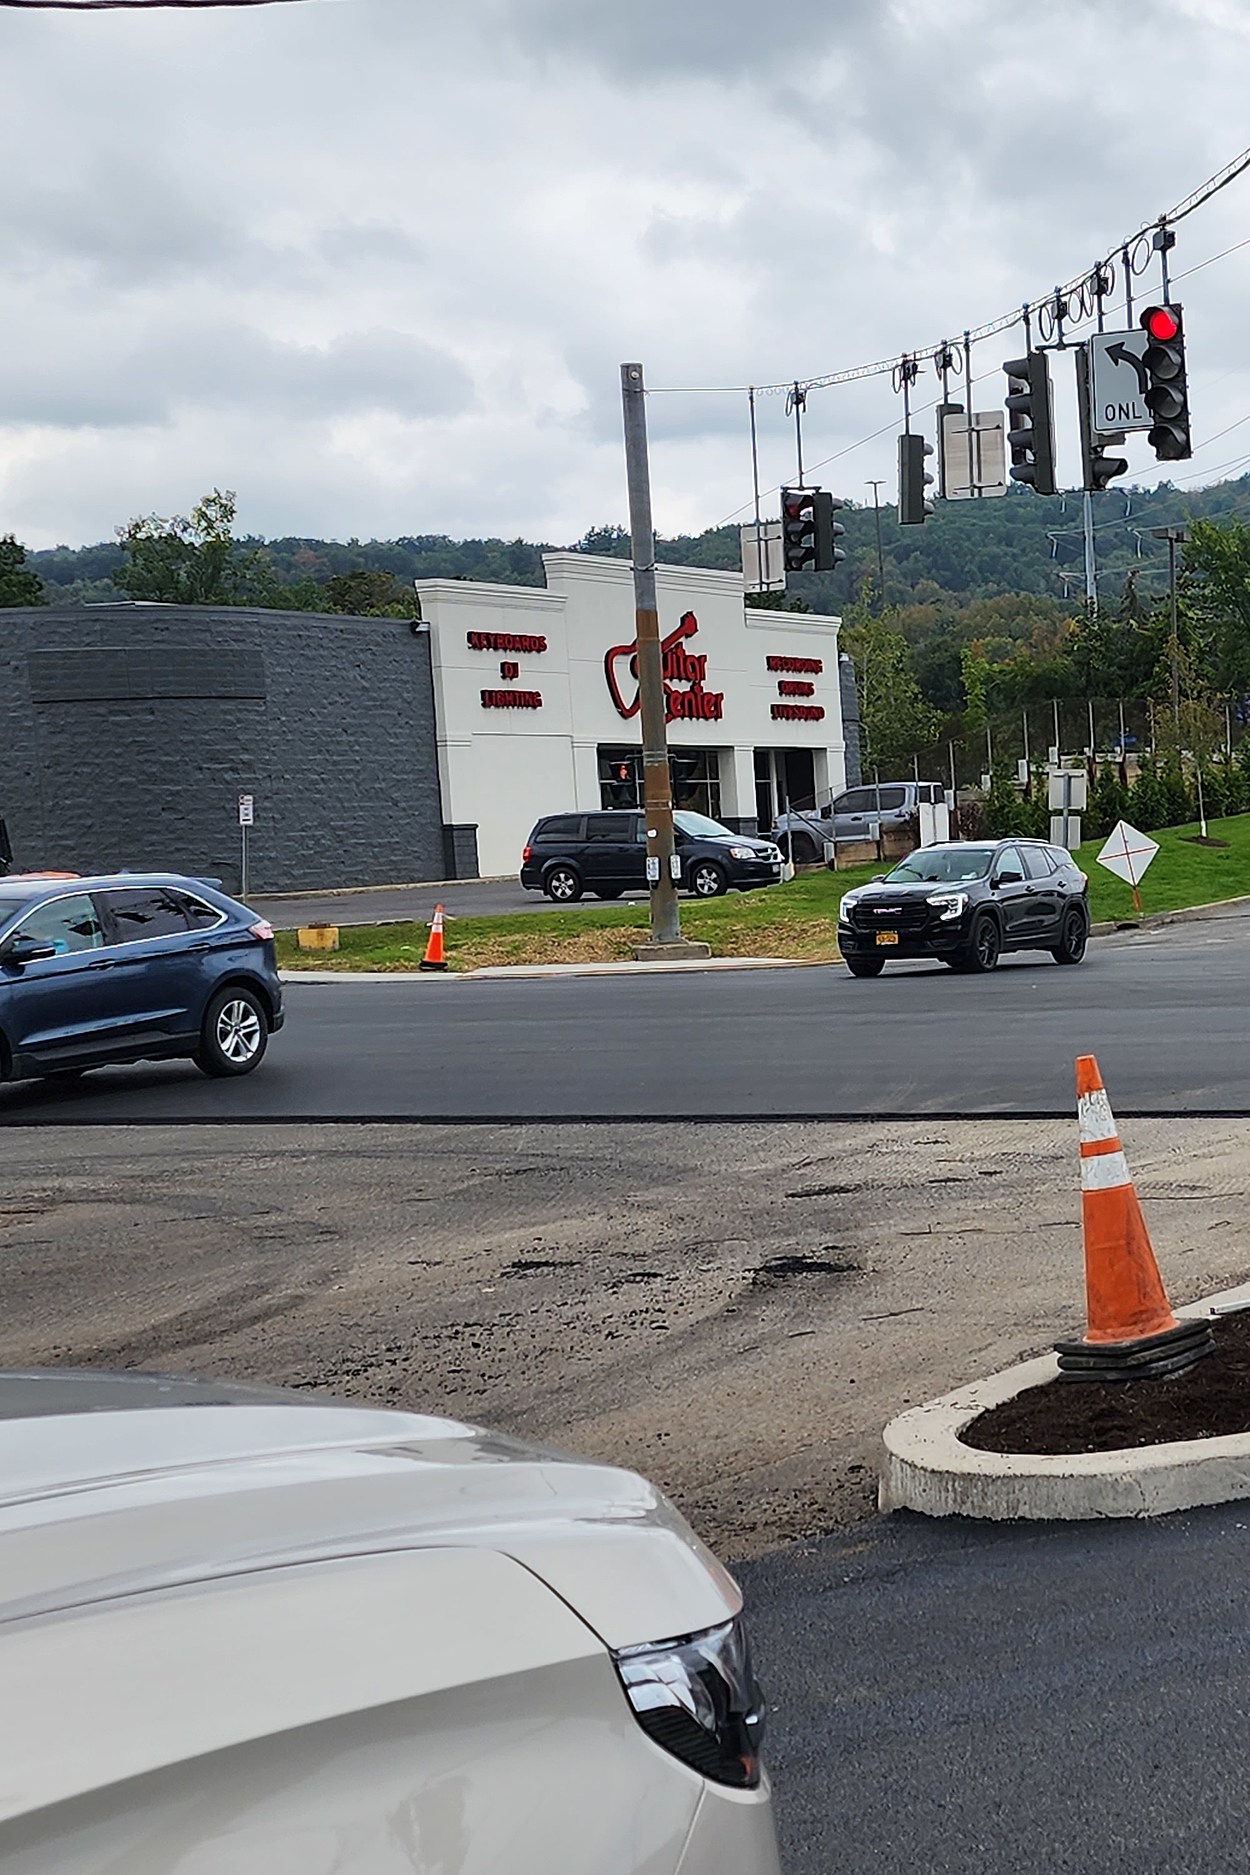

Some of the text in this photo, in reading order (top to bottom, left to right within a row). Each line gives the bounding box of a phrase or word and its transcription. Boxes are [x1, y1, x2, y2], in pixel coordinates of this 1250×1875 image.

[1105, 402, 1155, 422] ONL
[467, 631, 548, 654] KEYBOARDS
[480, 689, 543, 710] LIGHTING
